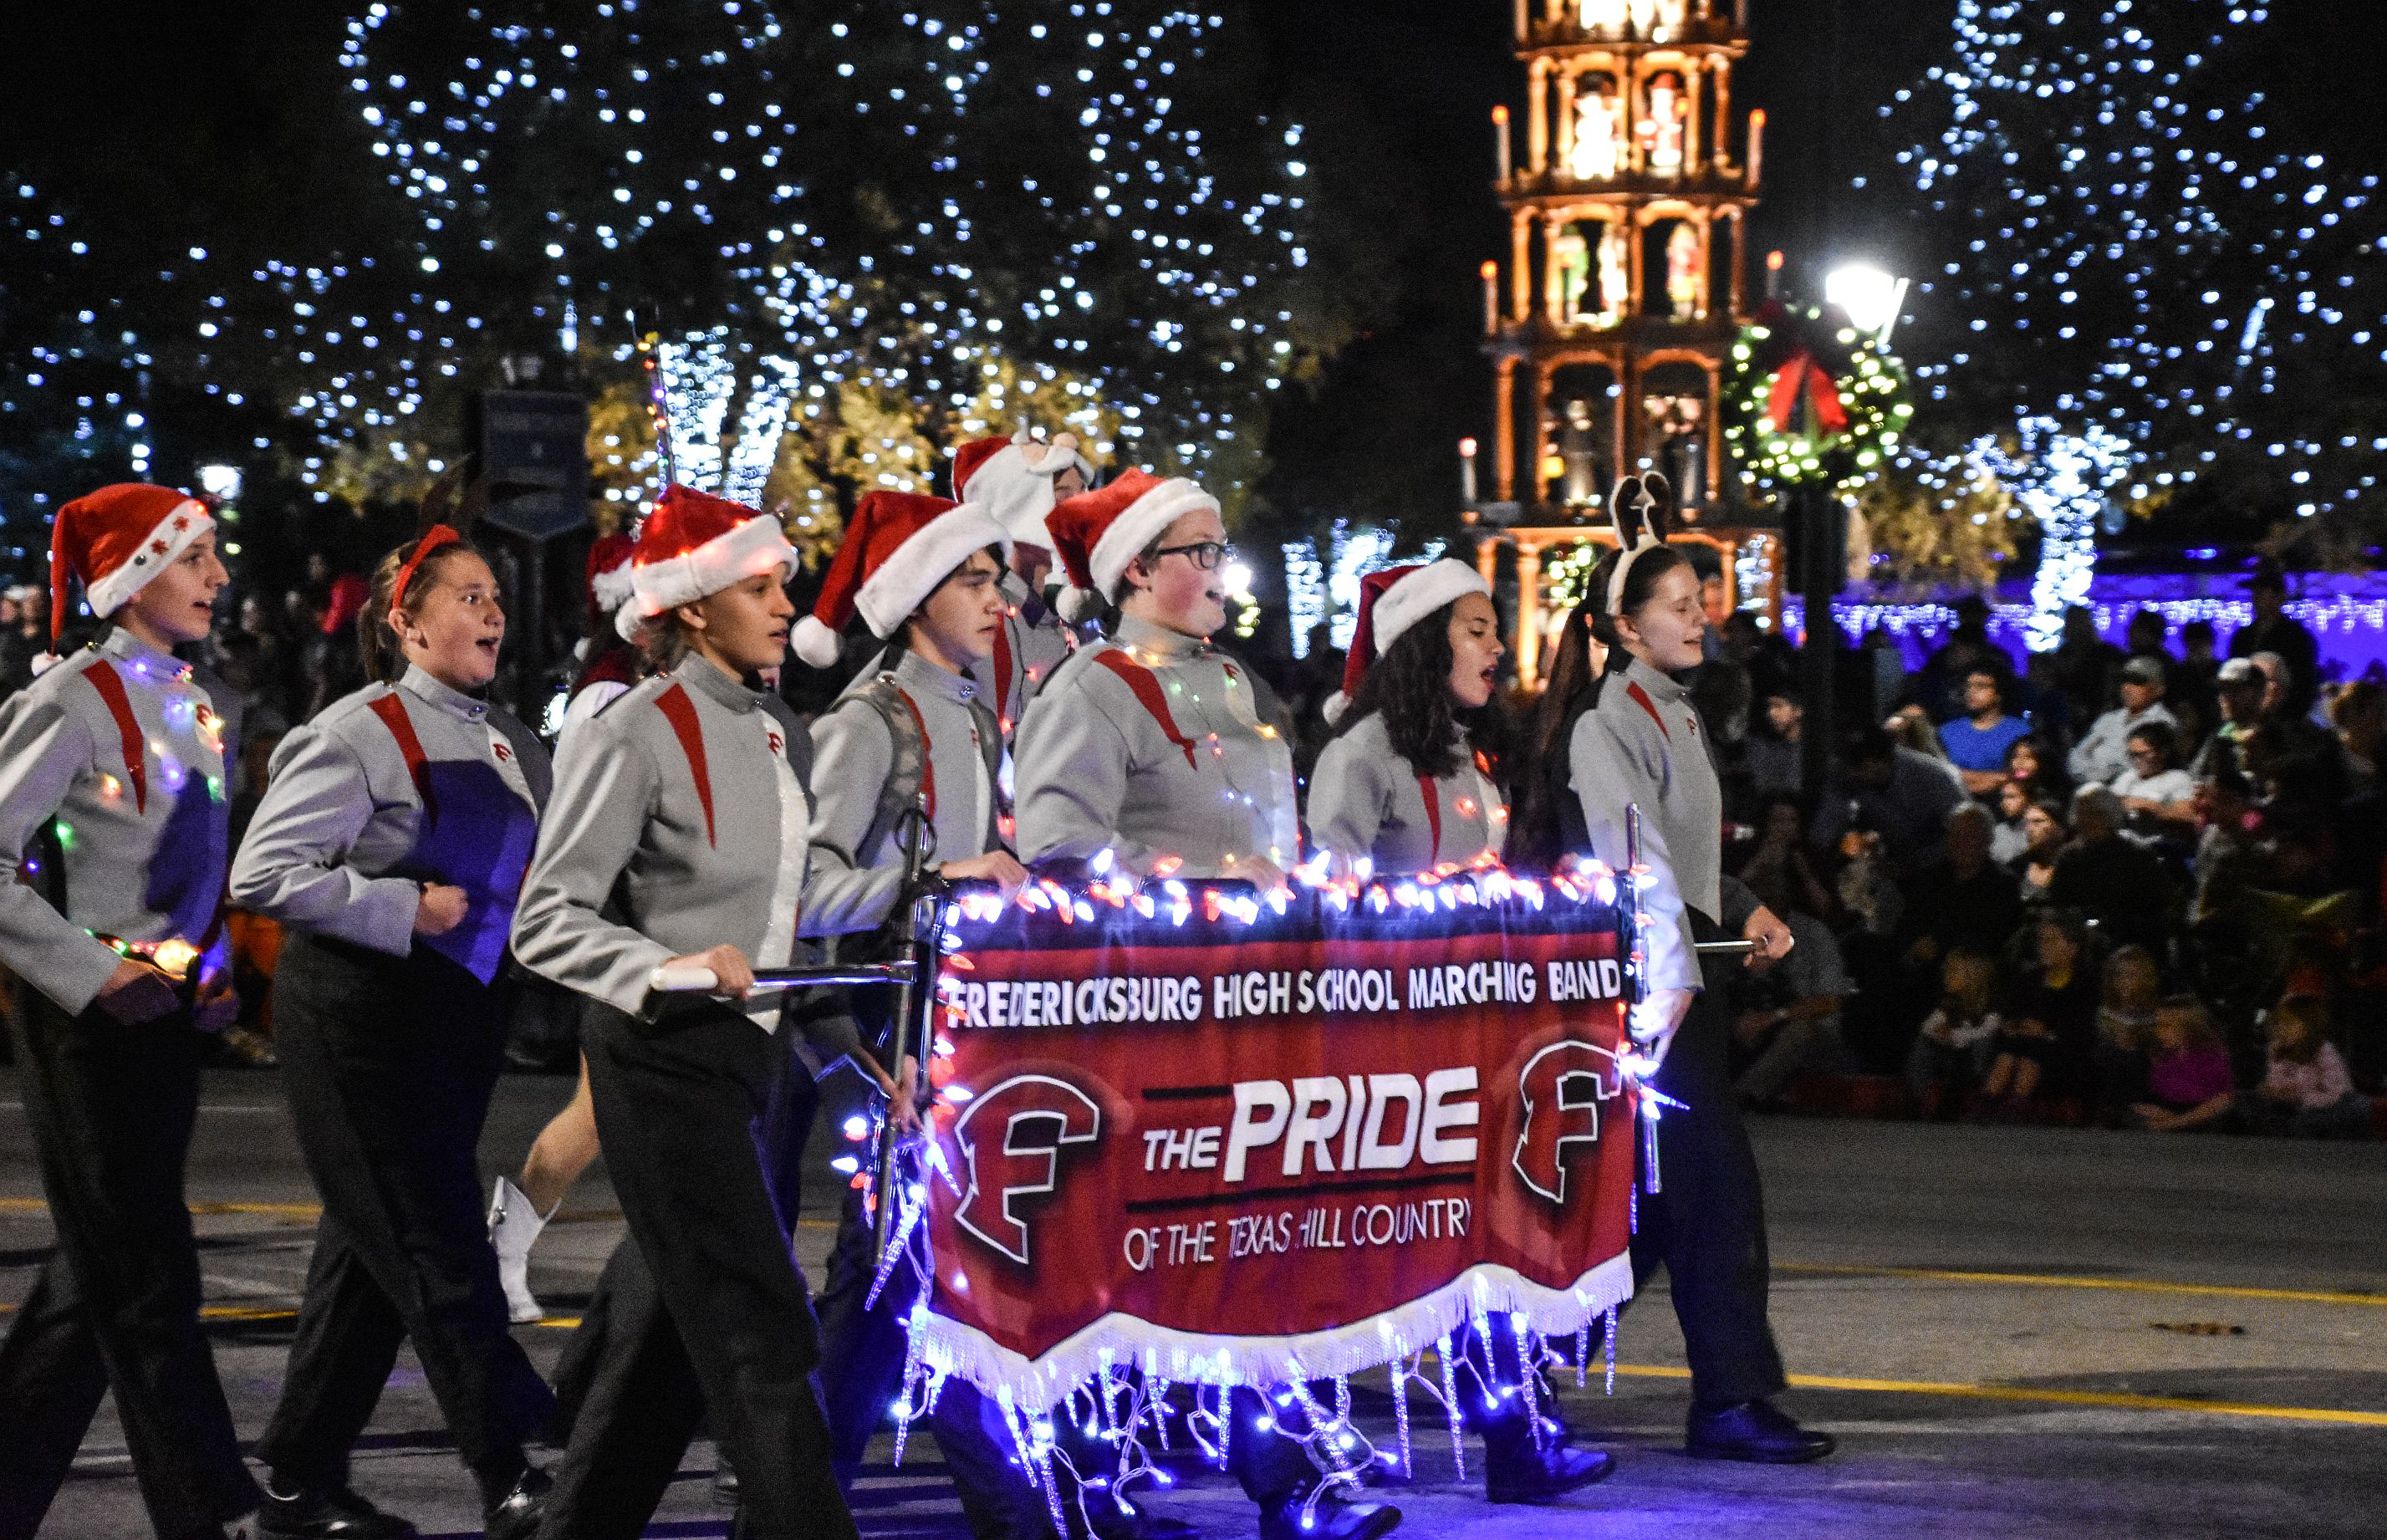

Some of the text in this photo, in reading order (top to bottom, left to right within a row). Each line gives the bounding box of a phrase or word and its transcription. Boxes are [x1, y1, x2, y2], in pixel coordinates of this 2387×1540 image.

[948, 976, 1202, 1028] FREDERICKSBURG
[1214, 971, 1292, 1018] HIGH
[1298, 968, 1400, 1013] SCHOOL
[1548, 959, 1621, 1002] BAND
[1143, 1066, 1479, 1182] THE PRIDE
[1124, 1227, 1161, 1271] OF
[1167, 1221, 1216, 1266] THE
[1227, 1211, 1293, 1258] TEXAS
[1296, 1208, 1346, 1248] HILL
